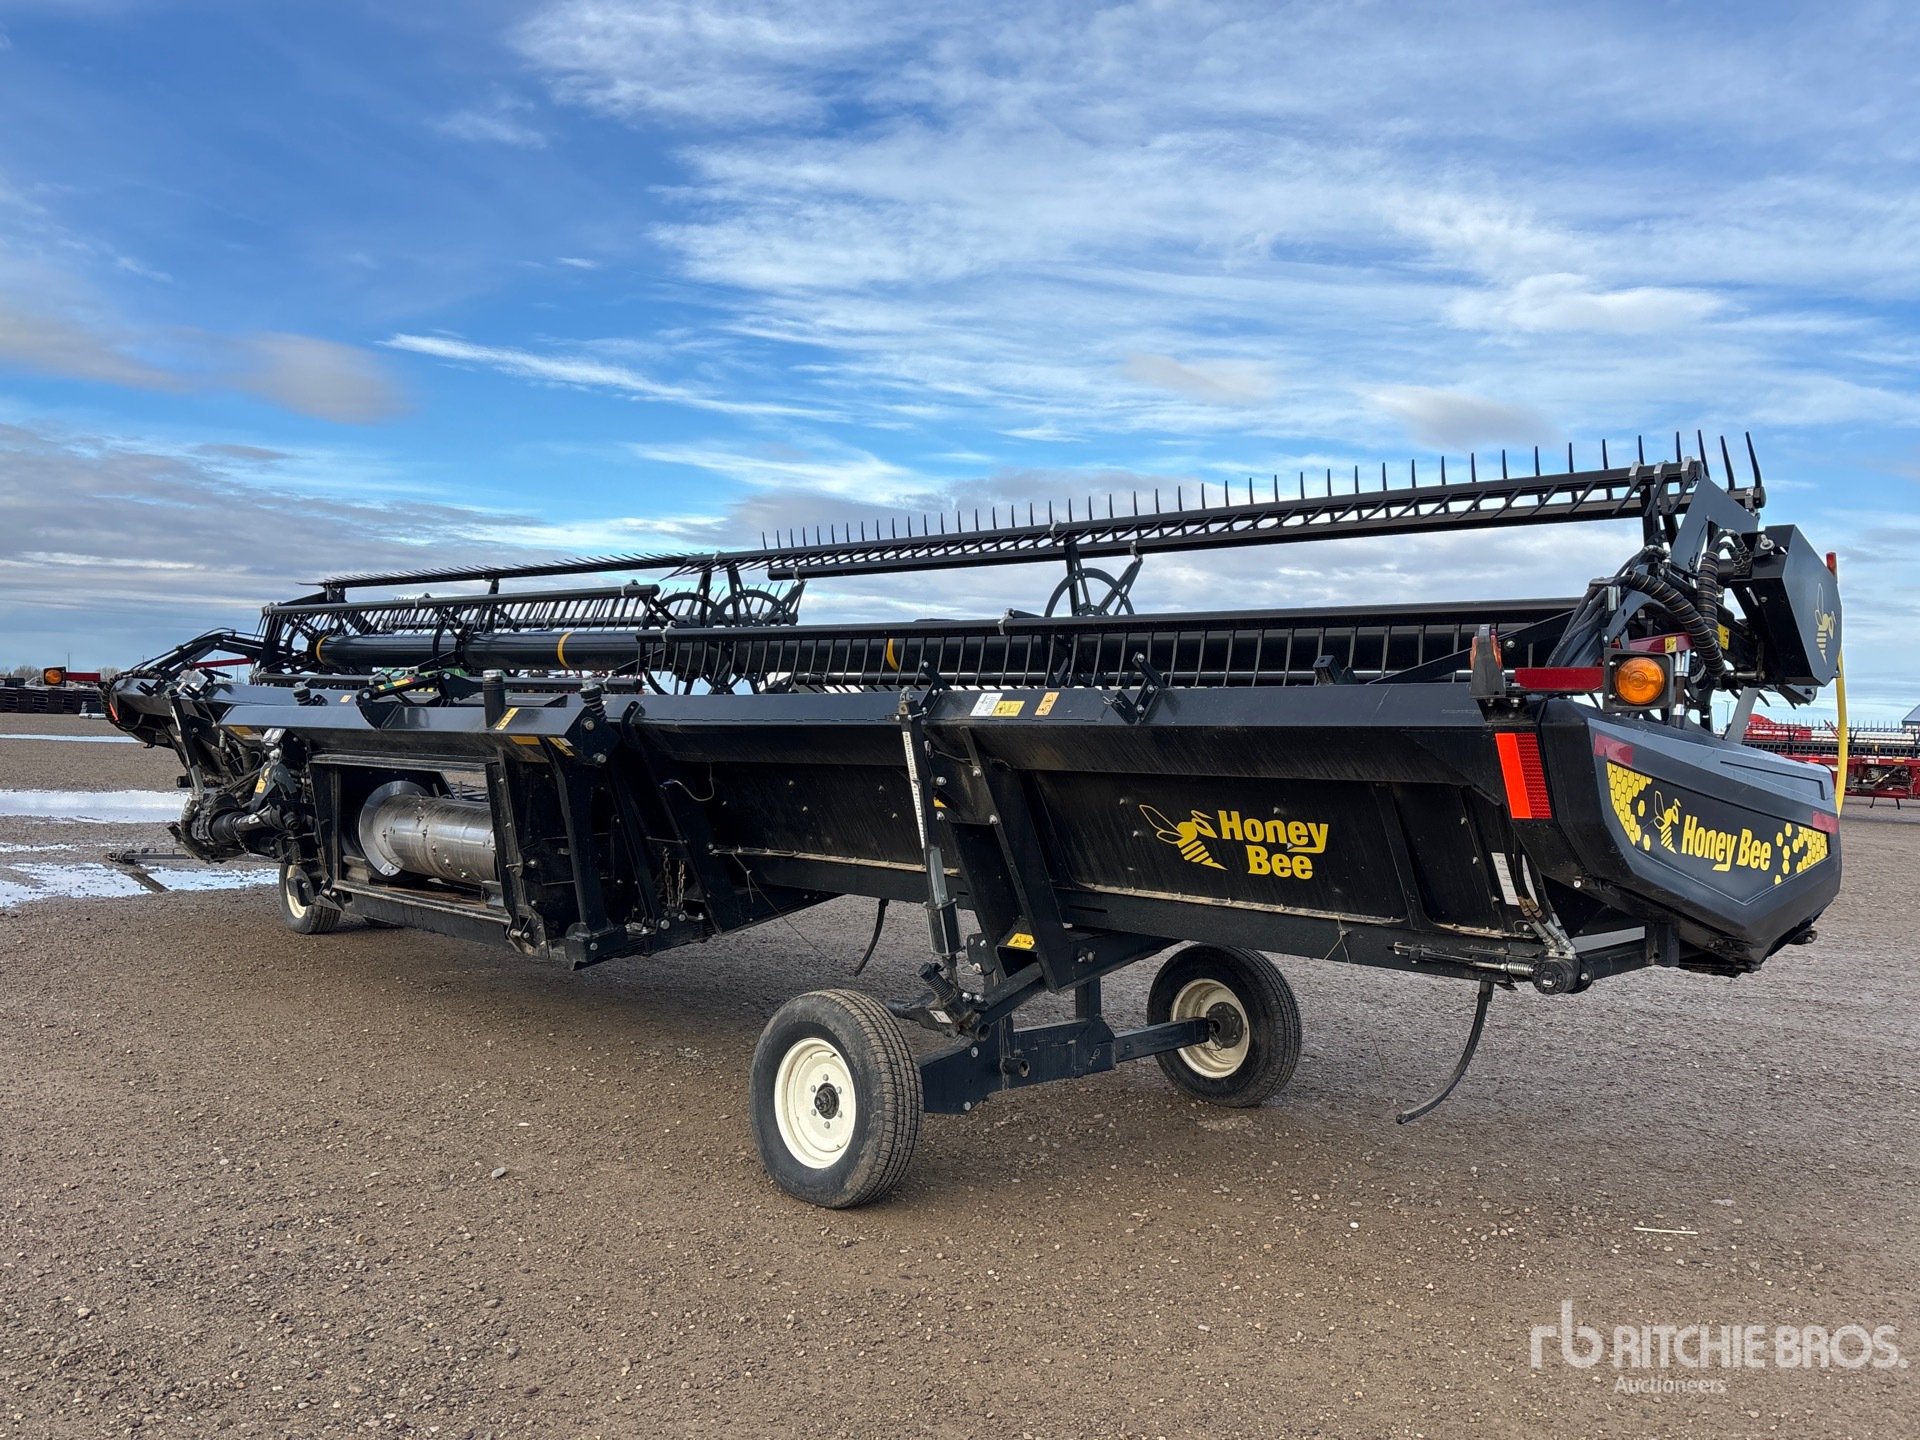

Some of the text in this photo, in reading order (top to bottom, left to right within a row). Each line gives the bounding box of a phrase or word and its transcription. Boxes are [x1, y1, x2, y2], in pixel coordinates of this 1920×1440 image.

[1218, 809, 1329, 854] Honey
[1681, 814, 1772, 872] Honey Bee
[1245, 844, 1314, 880] Bee
